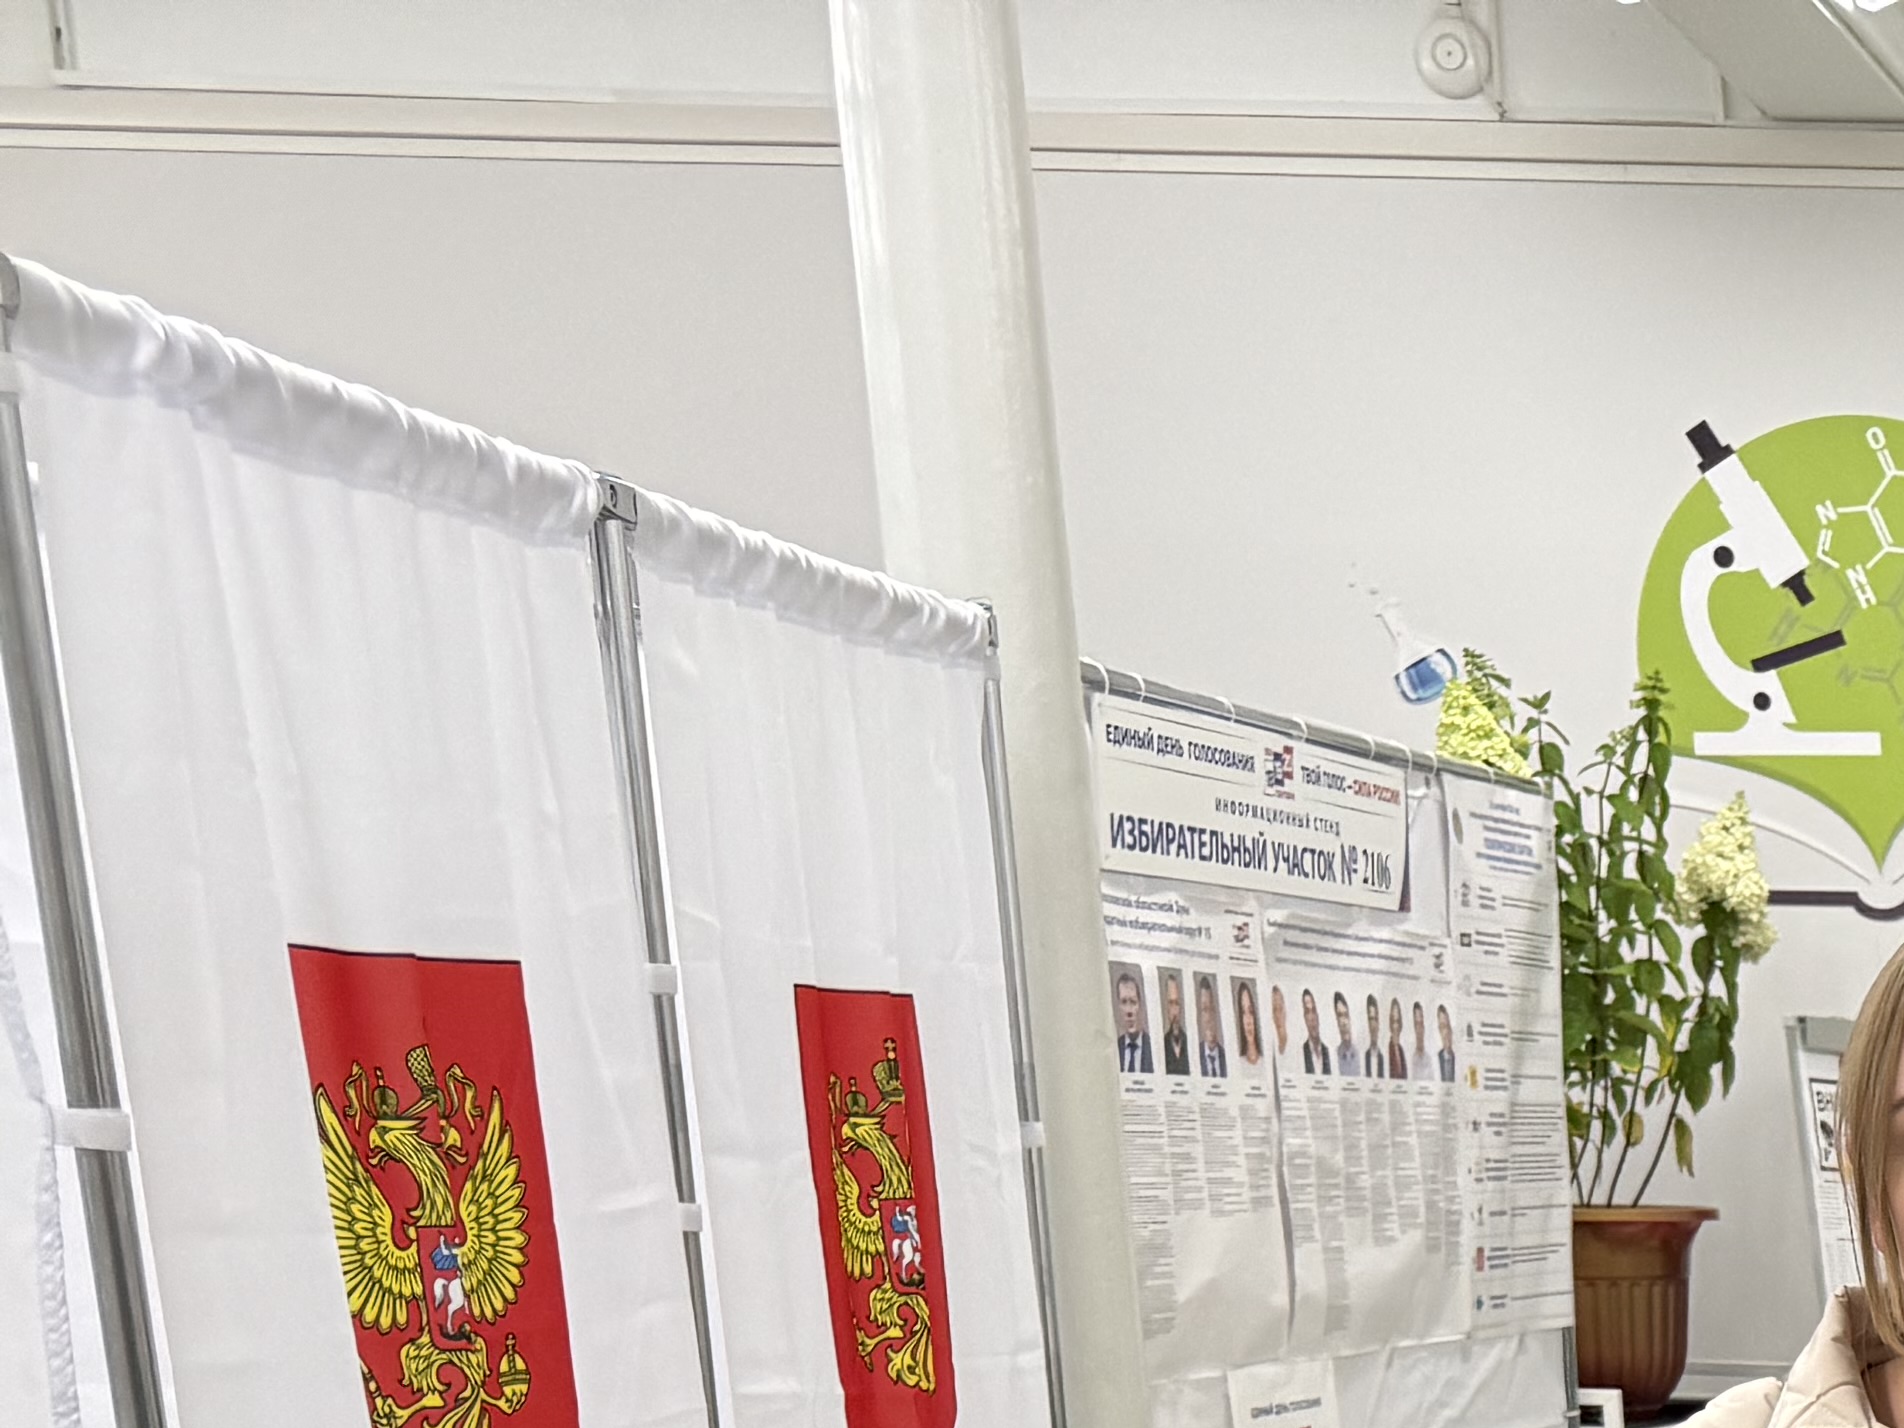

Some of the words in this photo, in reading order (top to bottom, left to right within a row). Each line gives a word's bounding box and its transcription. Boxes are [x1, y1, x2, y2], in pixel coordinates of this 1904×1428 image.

[1815, 500, 1838, 525] N
[1105, 723, 1154, 752] ЕДИНЫЙ
[1156, 734, 1184, 758] ДЕНЬ
[1187, 741, 1256, 774] ГОЛОСОВАНИЯ
[1214, 797, 1311, 829] ИНФОРМАЦИОННЫЙ
[1109, 812, 1268, 872] ИЗБИРАТЕЛЬНЫЙ
[1270, 840, 1337, 884] УЧАСТОК
[1340, 843, 1359, 886] №
[1361, 849, 1392, 890] 2106
